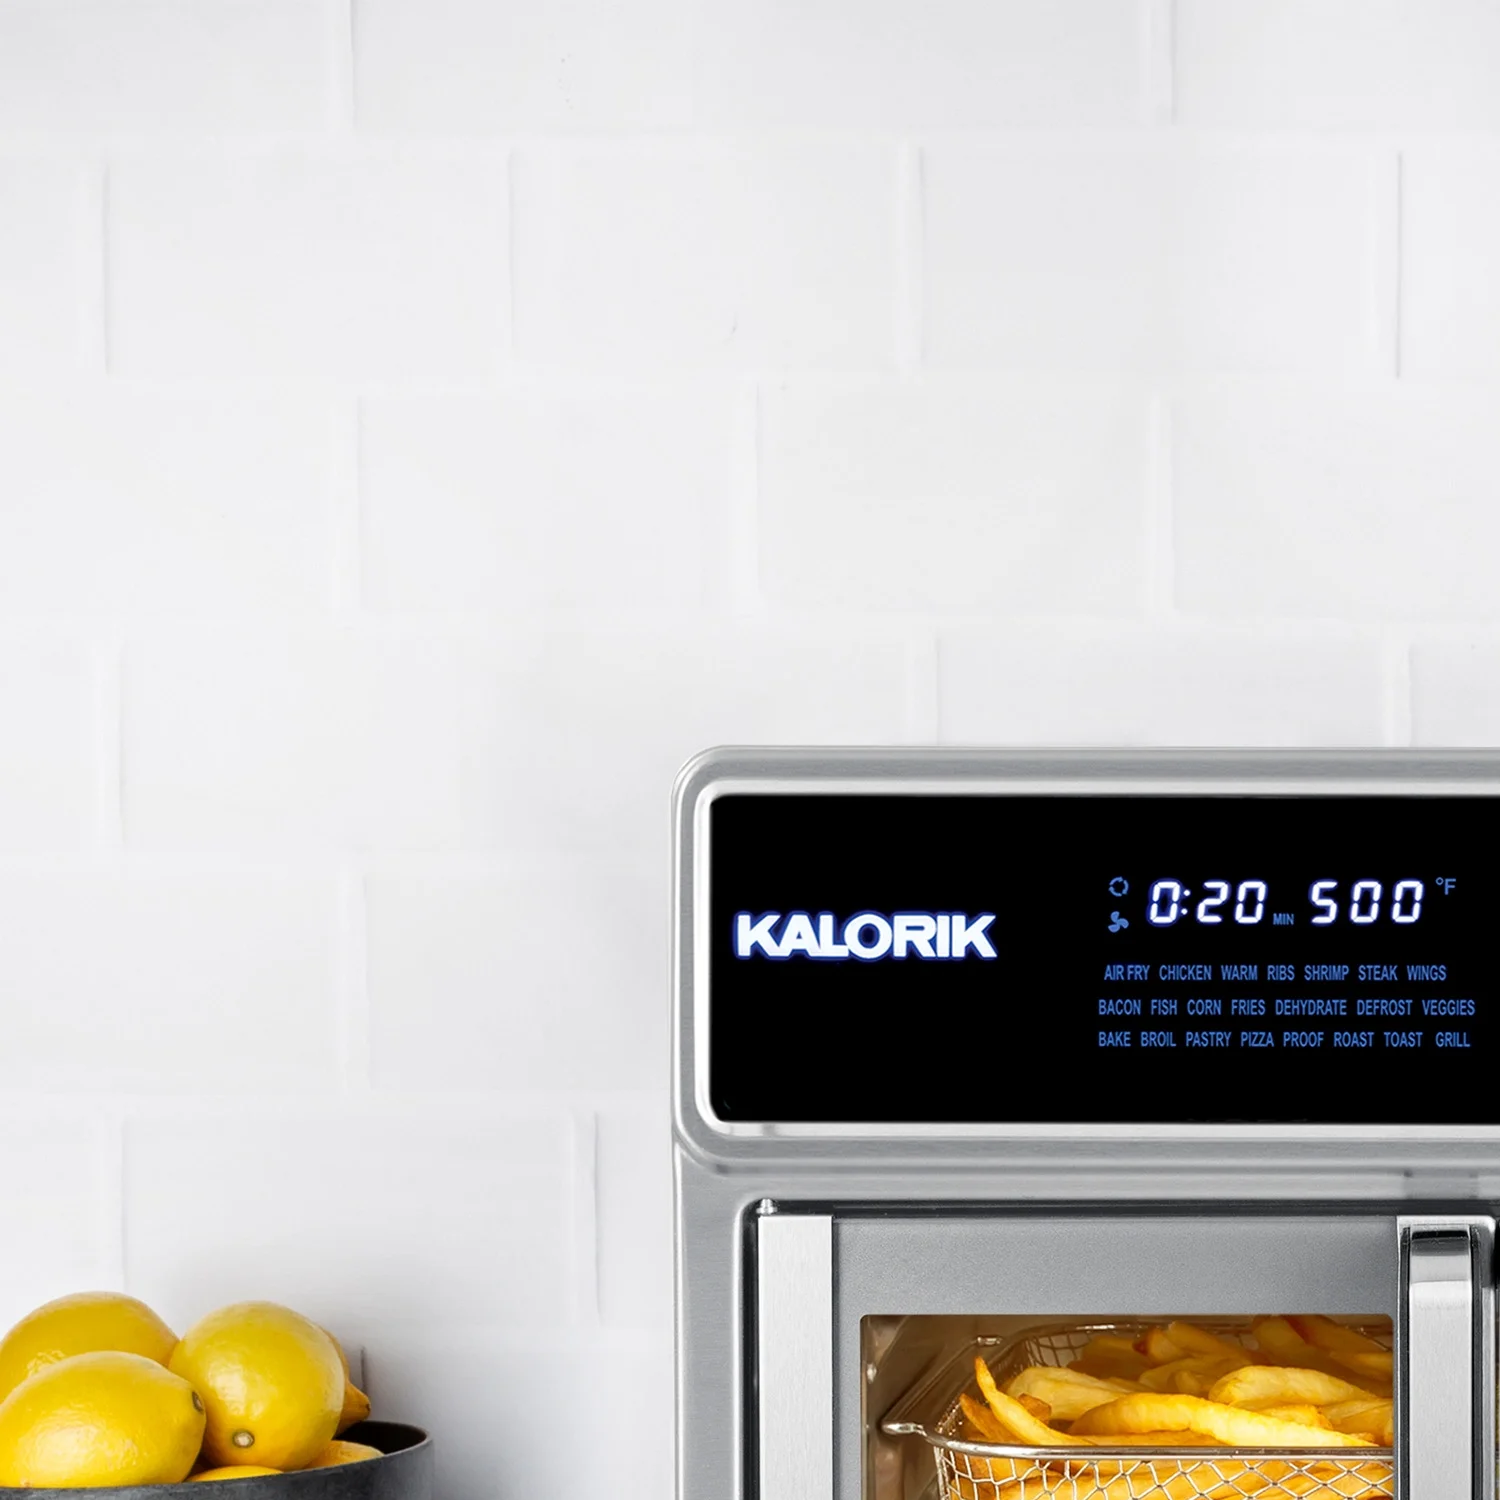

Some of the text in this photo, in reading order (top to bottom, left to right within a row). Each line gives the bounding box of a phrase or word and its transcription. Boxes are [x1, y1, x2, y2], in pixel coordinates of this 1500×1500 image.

[1149, 880, 1295, 925] 0:20 MIN
[1310, 879, 1424, 925] 500
[737, 913, 998, 960] KALORIK
[1103, 964, 1447, 981] AIR FRY CHICKEN WARM RIBS SHRIMP STEAK WINGS
[1098, 998, 1476, 1016] BACON FISH CORN FRIES DEHYDRATE DEFROST VEGGIES
[1098, 1031, 1471, 1048] BAKE BROIL PASTRY PIZZA PROOF ROAST TOAST GRILL
